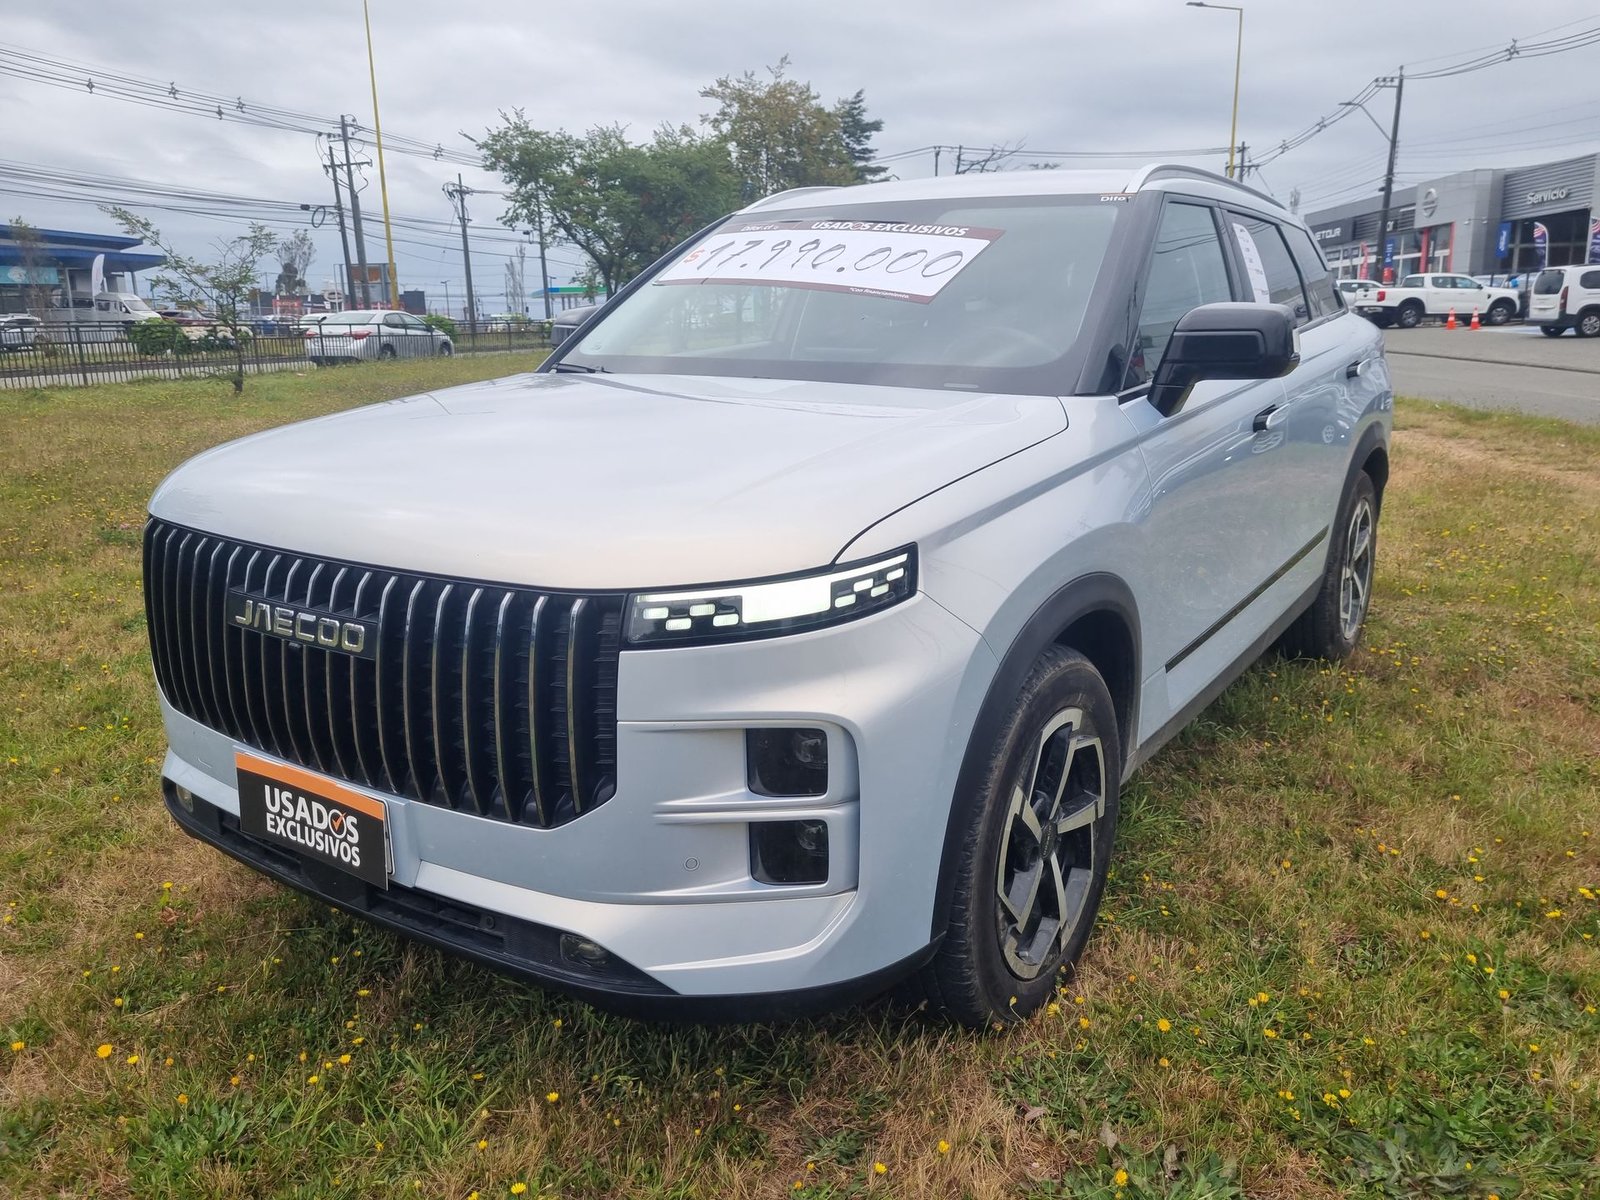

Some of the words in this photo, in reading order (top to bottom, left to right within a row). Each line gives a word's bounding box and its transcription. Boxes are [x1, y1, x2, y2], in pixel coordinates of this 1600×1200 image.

[1527, 188, 1566, 204] Servicio
[811, 221, 872, 232] USADOS
[871, 224, 968, 236] EXCLUSIVOS
[1314, 227, 1341, 241] ETOUR
[235, 599, 365, 653] JAECOO
[264, 784, 359, 845] USADOS
[265, 811, 361, 867] EXCLUSIVOS
